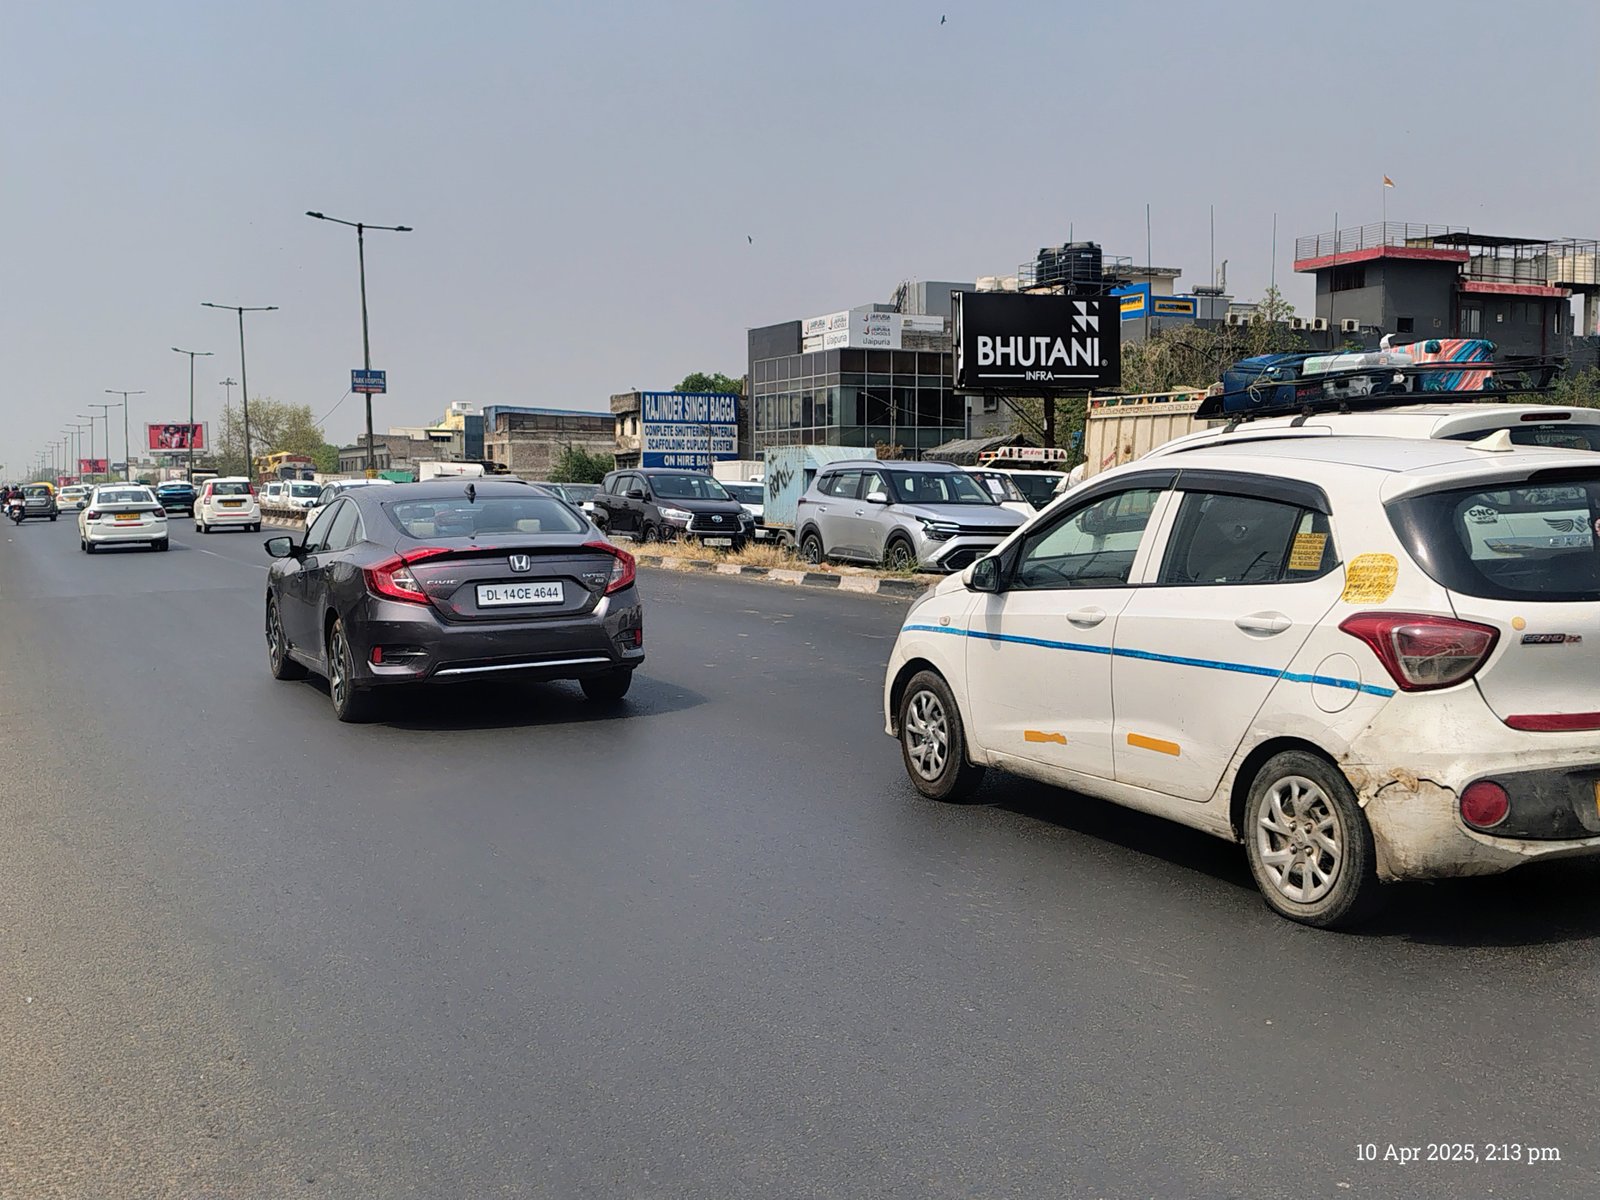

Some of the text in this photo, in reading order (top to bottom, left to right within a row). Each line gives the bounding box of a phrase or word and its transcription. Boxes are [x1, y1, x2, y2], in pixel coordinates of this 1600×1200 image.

[978, 336, 1099, 366] BHUTANI
[1026, 371, 1054, 381] INFRA
[645, 395, 736, 422] RAJINDER SINGH BAGGA
[645, 425, 674, 436] COMPLETE
[710, 427, 736, 438] MATERIAL
[648, 439, 685, 450] SCAFFOLDING
[713, 440, 733, 451] SYSTEM
[664, 455, 675, 466] ON
[677, 455, 695, 466] HIRE
[486, 589, 501, 601] DL
[534, 587, 558, 598] 4644
